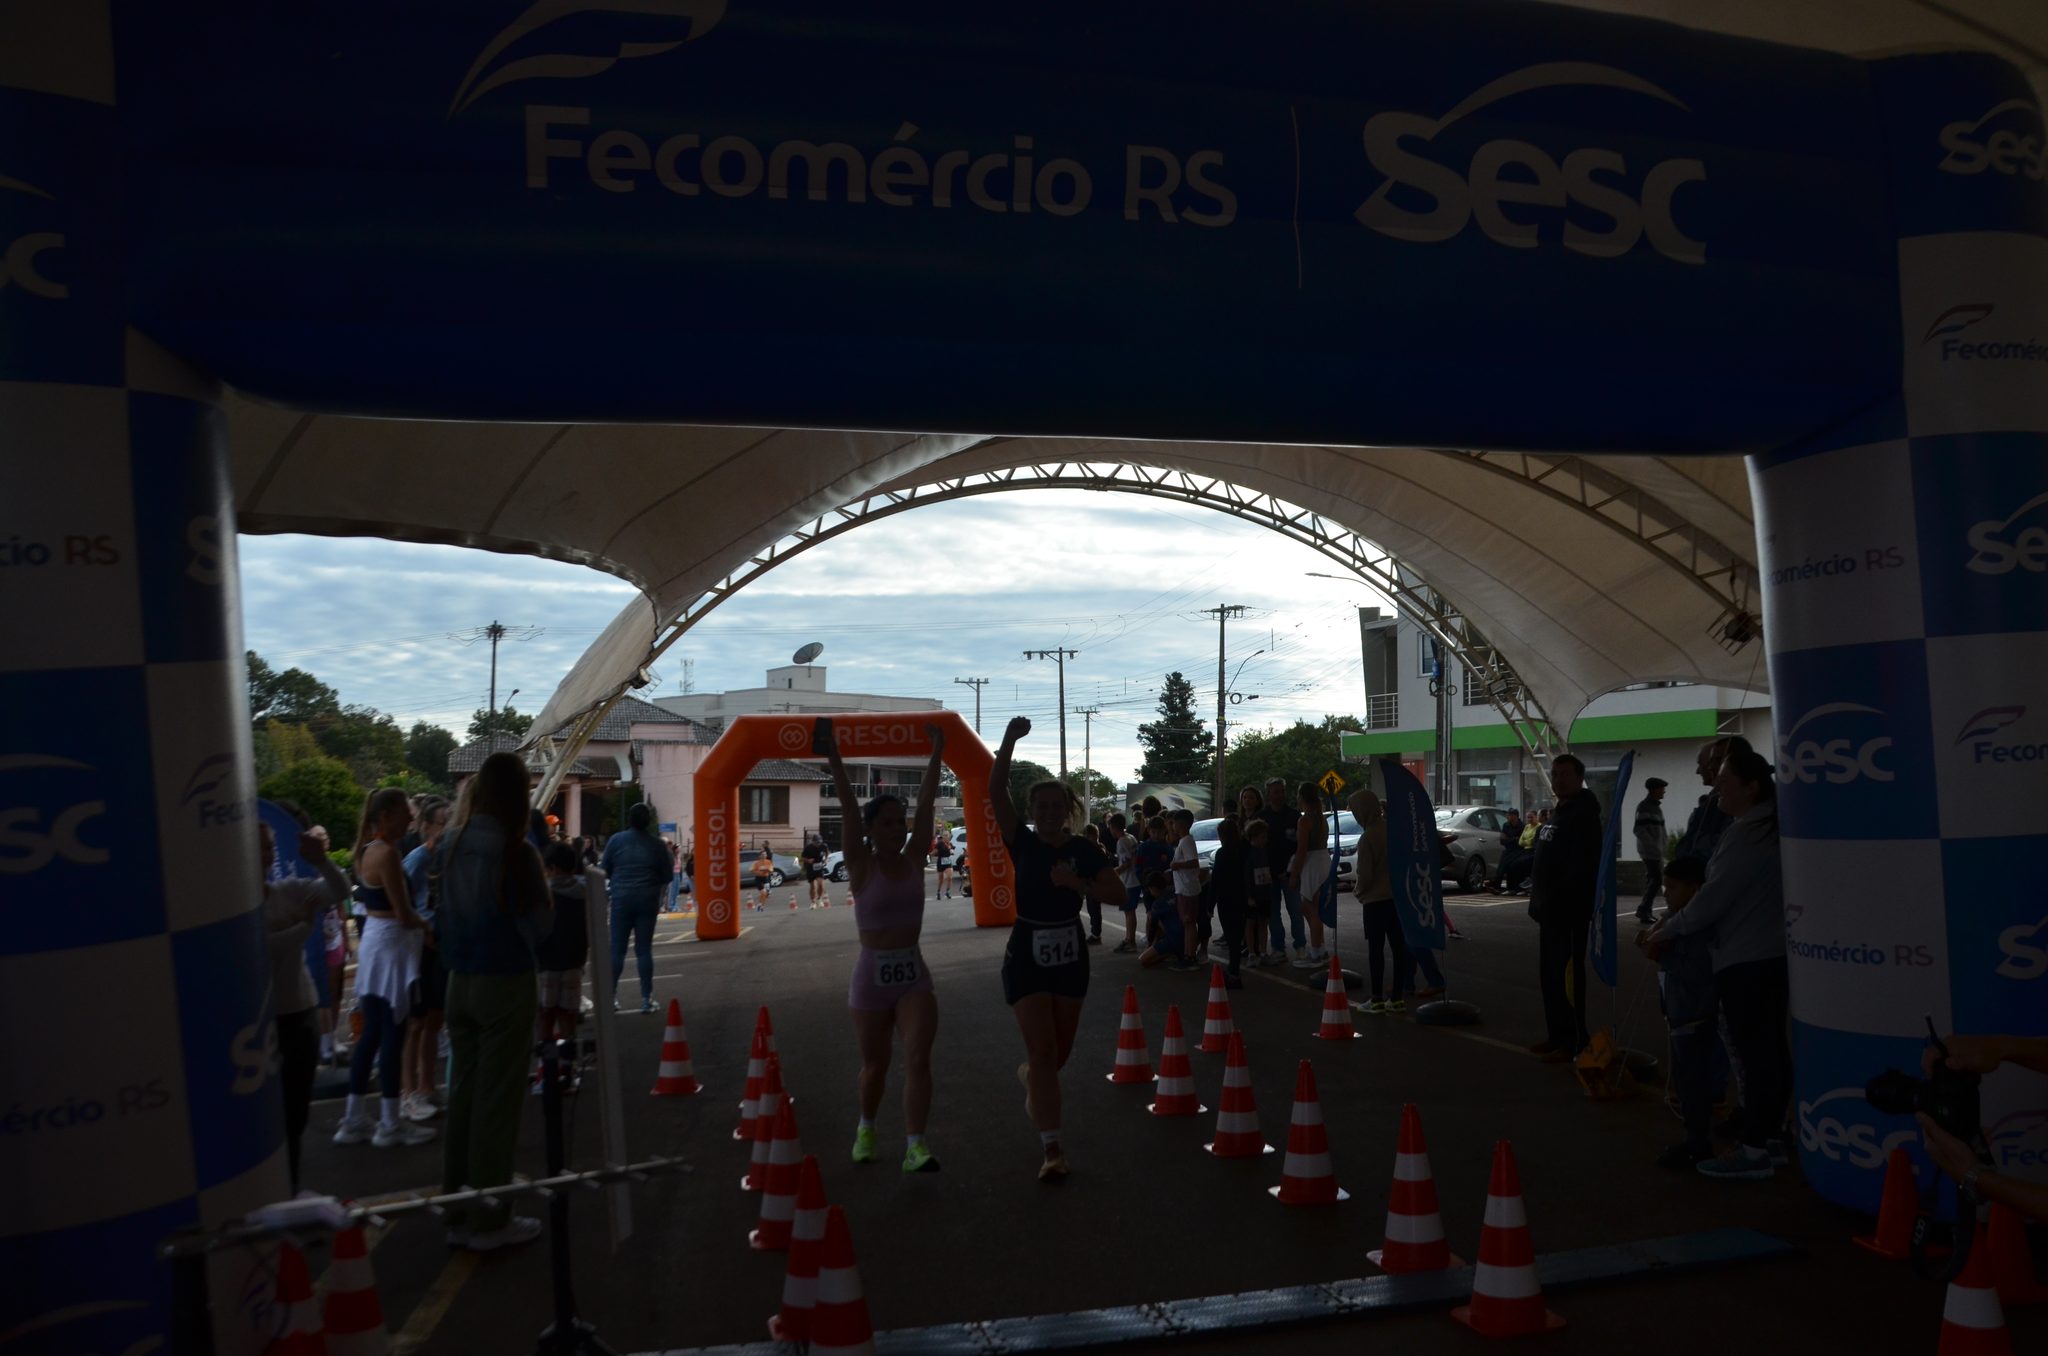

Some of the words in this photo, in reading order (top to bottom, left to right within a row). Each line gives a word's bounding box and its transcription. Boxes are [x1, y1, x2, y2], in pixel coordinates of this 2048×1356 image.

[525, 104, 1093, 216] Fecomércio
[1123, 144, 1239, 228] RS
[64, 535, 120, 566] RS
[1865, 546, 1905, 571] RS
[833, 724, 924, 746] RESOL
[708, 801, 728, 892] CRESOL
[1040, 941, 1074, 964] 514
[1894, 944, 1935, 967] RS
[880, 961, 916, 984] 663
